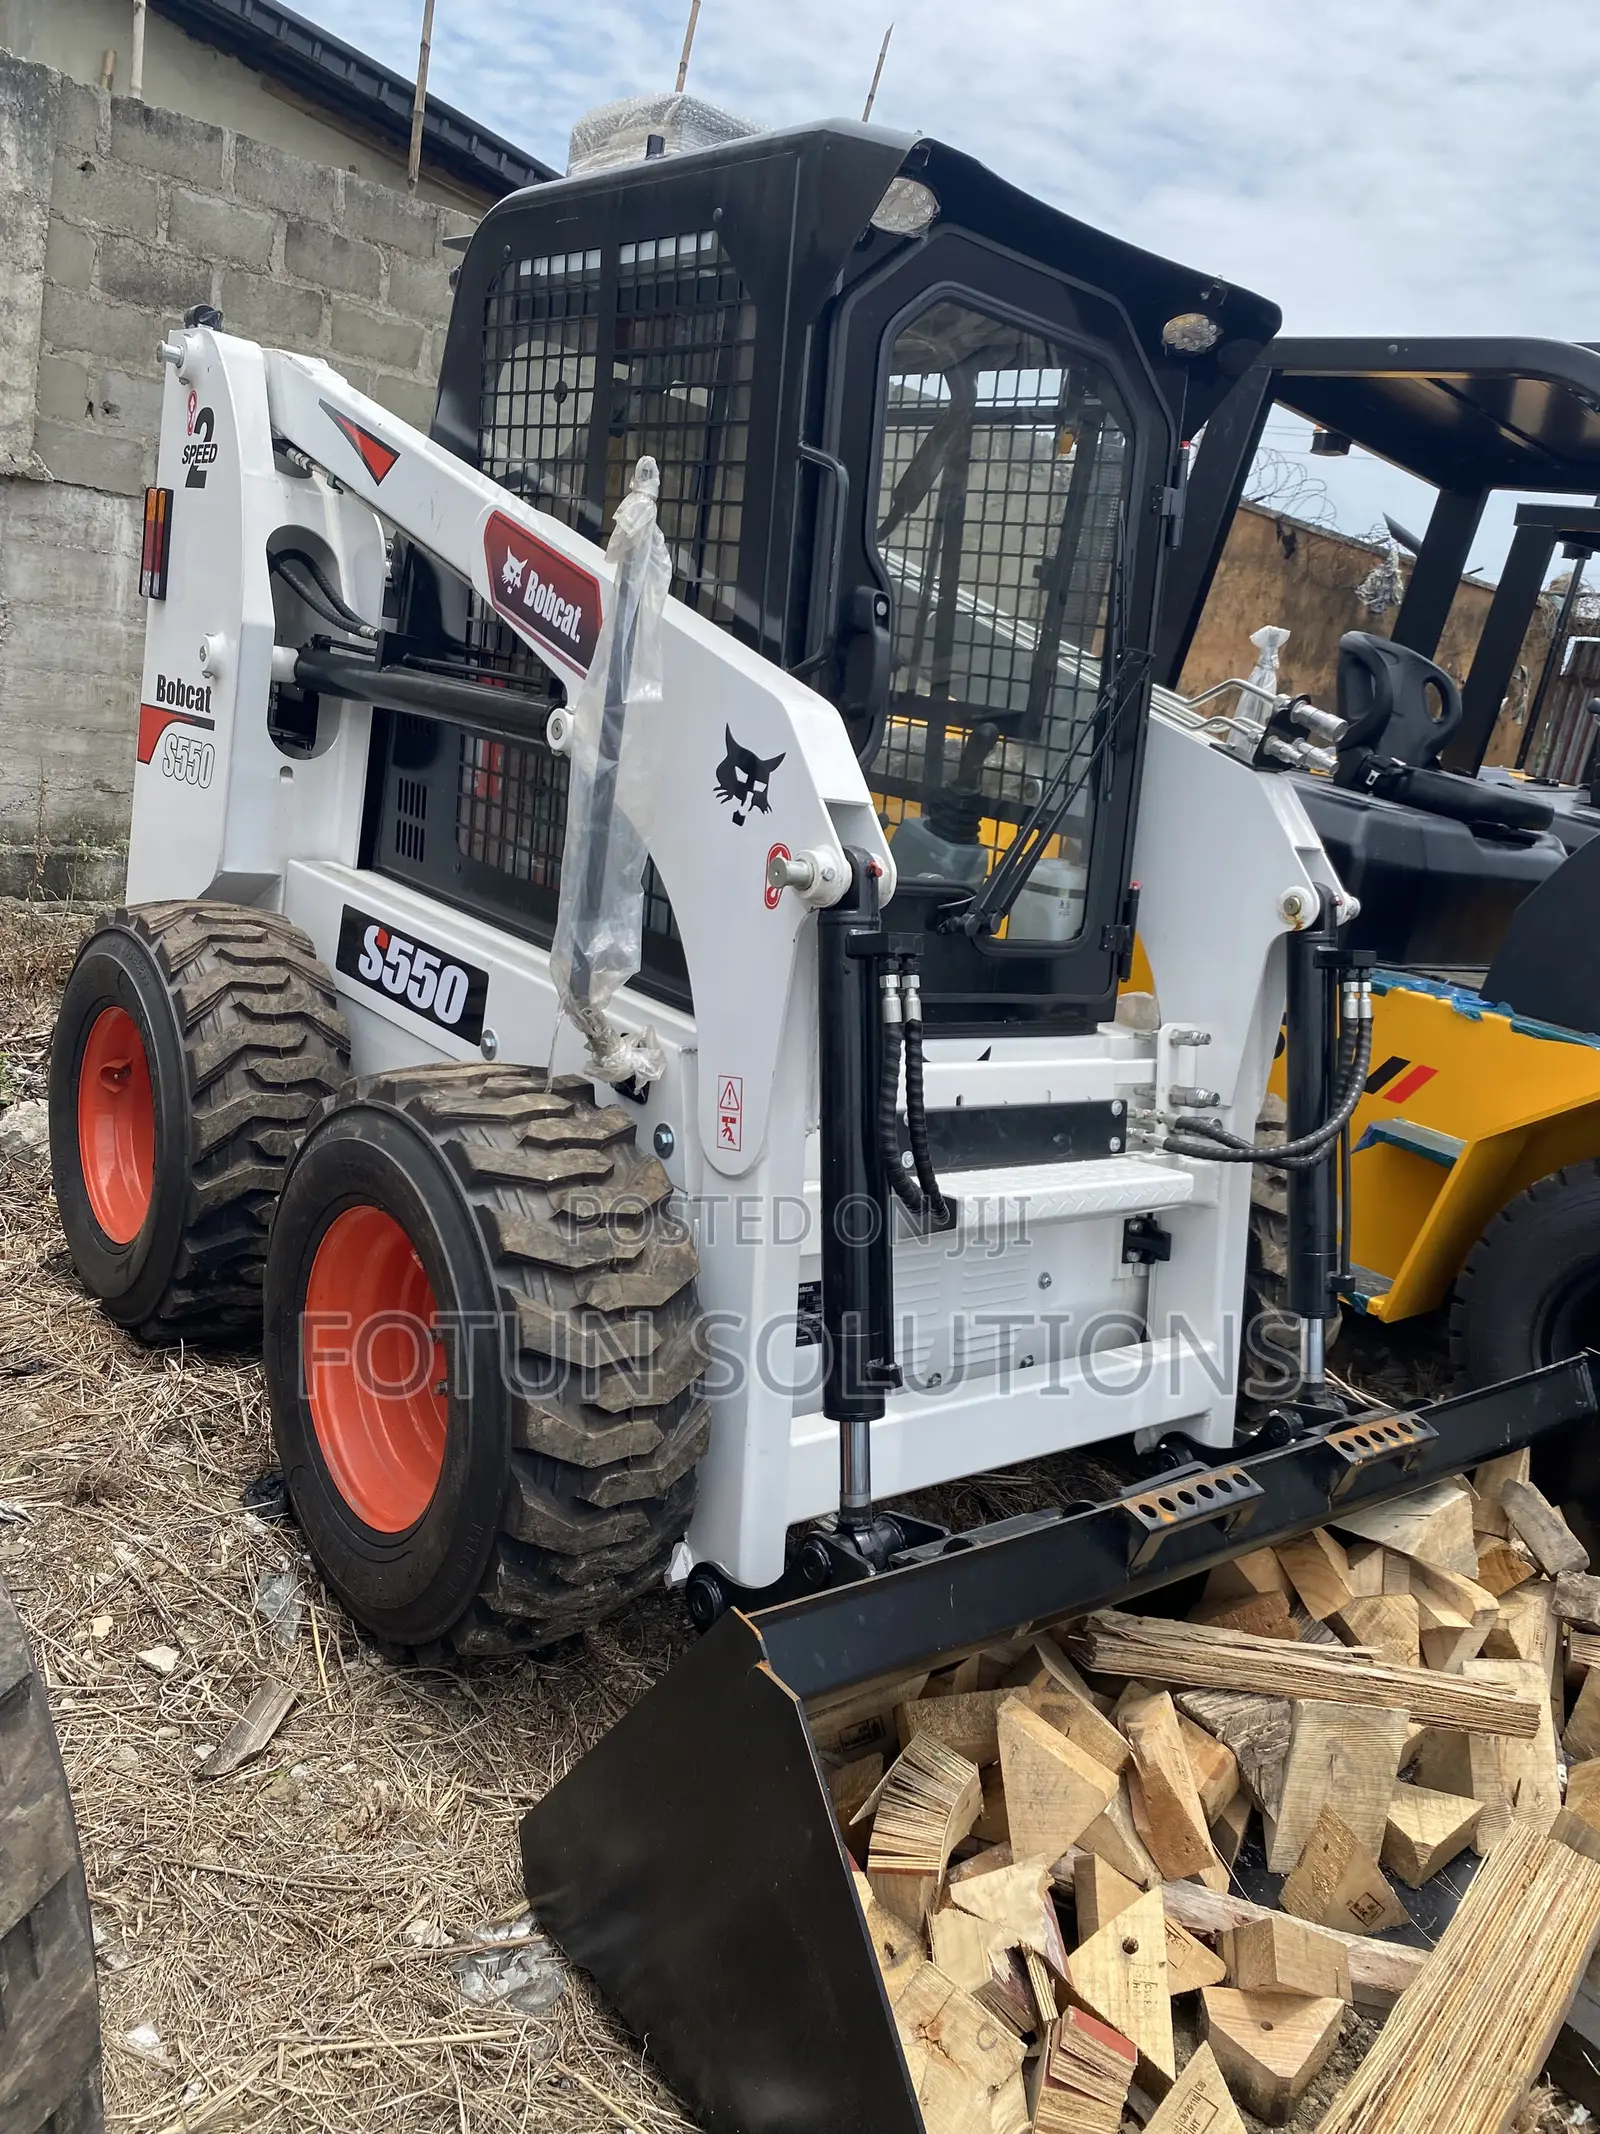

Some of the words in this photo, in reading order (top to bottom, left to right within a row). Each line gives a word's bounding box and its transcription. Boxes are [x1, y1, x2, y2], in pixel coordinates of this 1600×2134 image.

[181, 443, 218, 465] SPEED
[156, 674, 212, 713] Bobcat
[162, 732, 215, 789] S550
[358, 924, 470, 1025] S550
